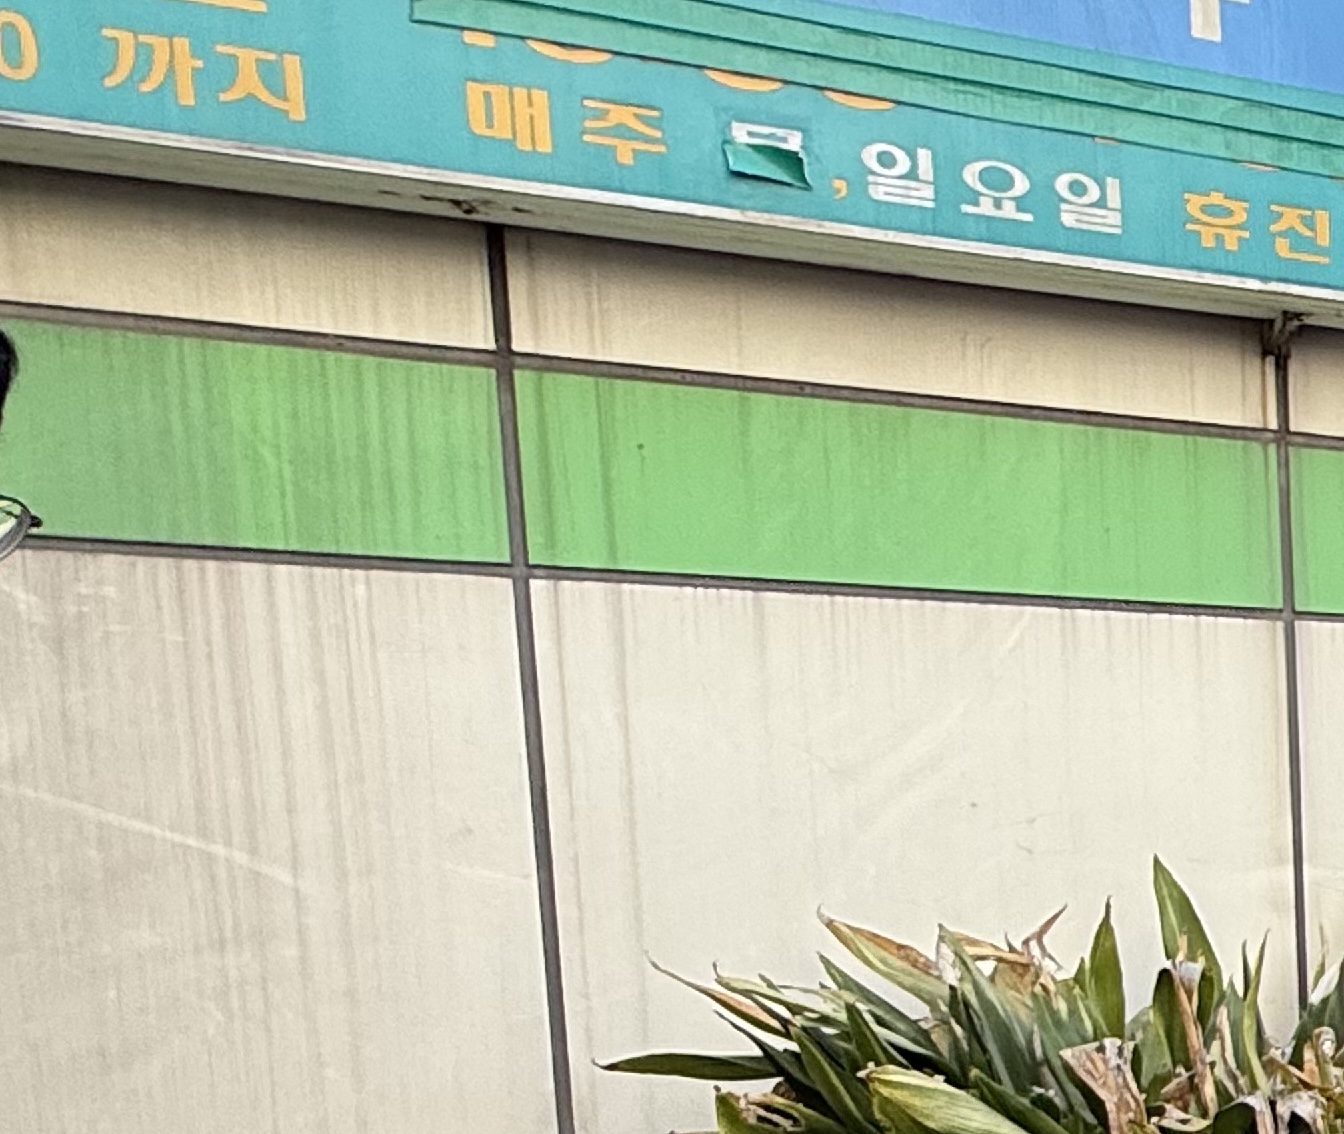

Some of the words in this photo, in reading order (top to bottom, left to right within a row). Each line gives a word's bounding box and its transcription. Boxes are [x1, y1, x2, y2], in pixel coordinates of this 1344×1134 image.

[100, 26, 306, 122] 까지
[465, 79, 667, 167] 매주
[1184, 188, 1332, 265] 휴진
